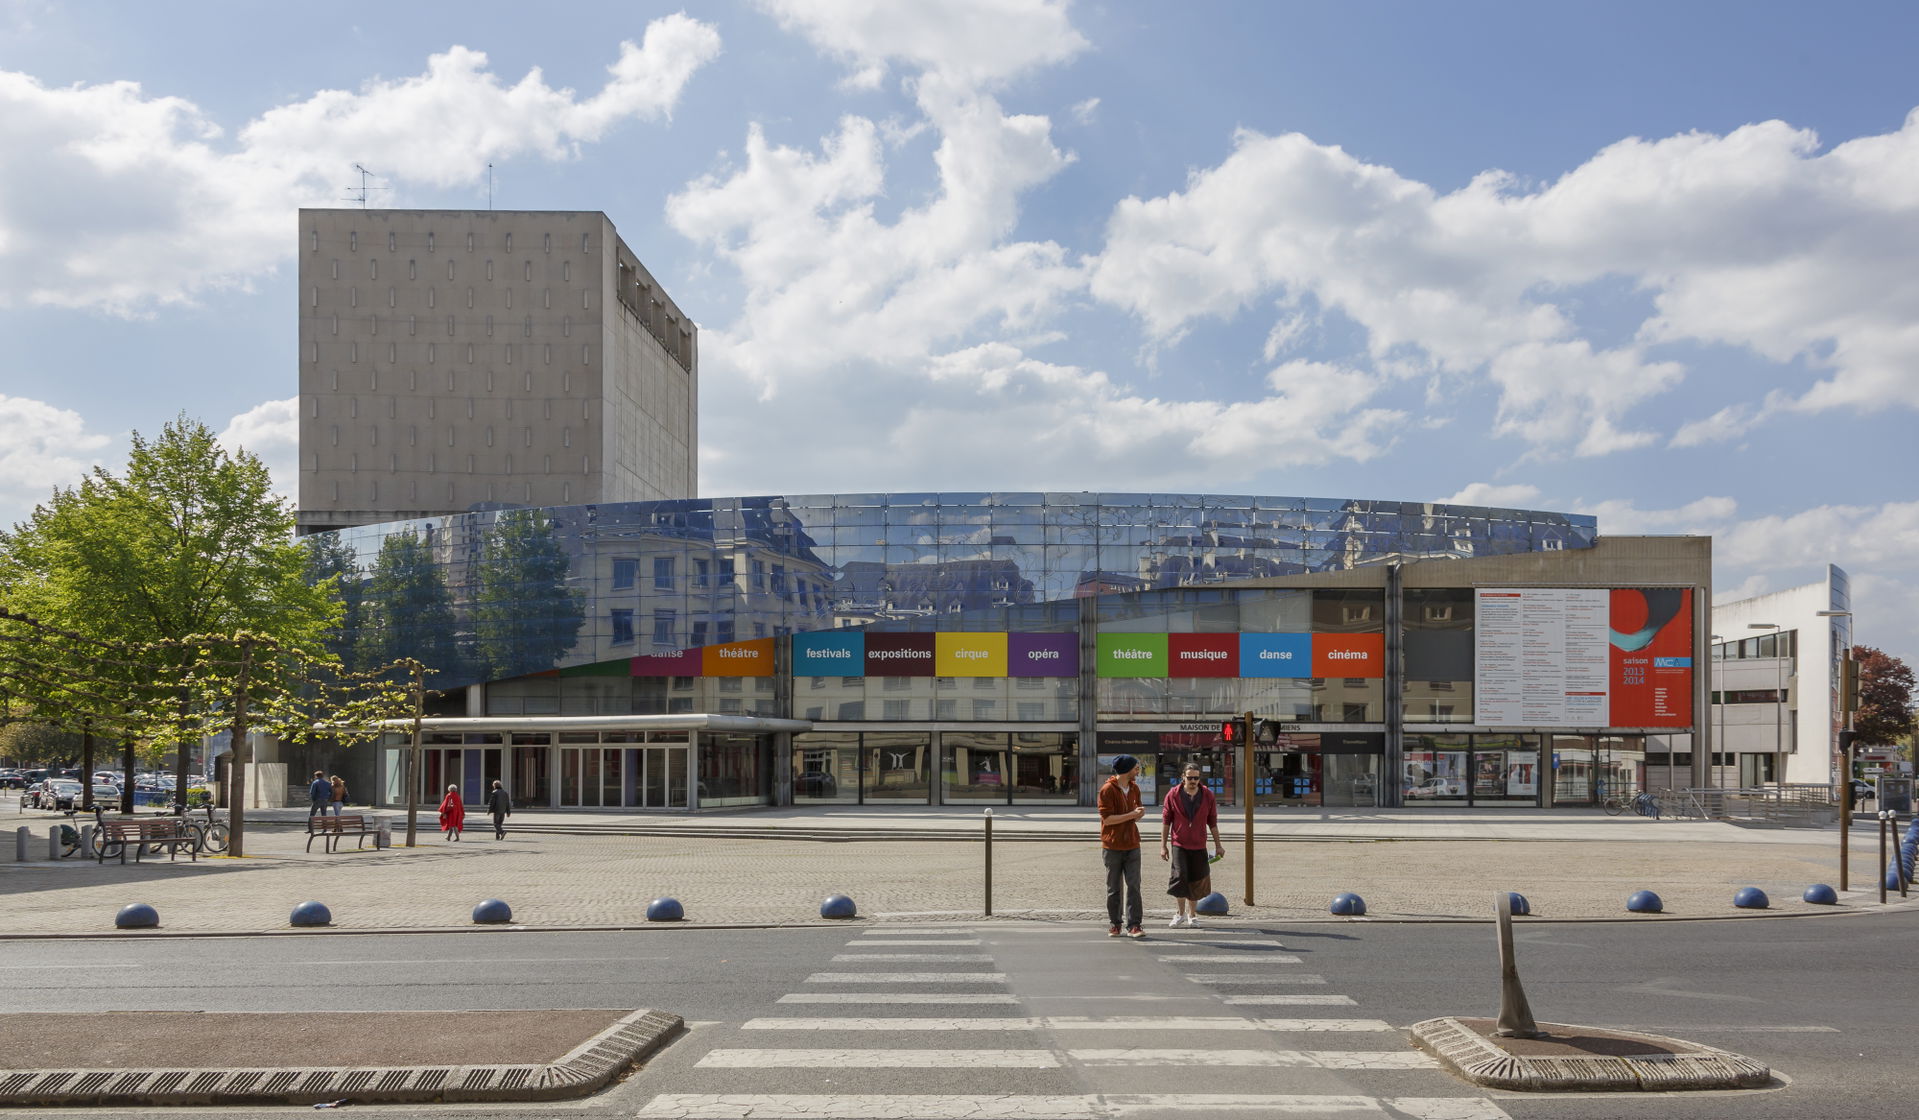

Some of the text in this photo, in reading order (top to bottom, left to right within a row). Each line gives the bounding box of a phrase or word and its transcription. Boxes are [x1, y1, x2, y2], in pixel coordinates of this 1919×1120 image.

[719, 648, 759, 658] théâtre
[806, 647, 852, 659] festivals
[868, 648, 932, 661] expositions
[955, 648, 989, 661] cirque
[1028, 648, 1059, 661] opéra
[1112, 649, 1152, 659] théâtre
[1180, 648, 1228, 661] musique
[1259, 649, 1292, 660] danse
[1328, 649, 1367, 660] cinéma
[1623, 657, 1648, 665] saison
[1623, 667, 1645, 676] 2013
[1623, 676, 1645, 685] 2014
